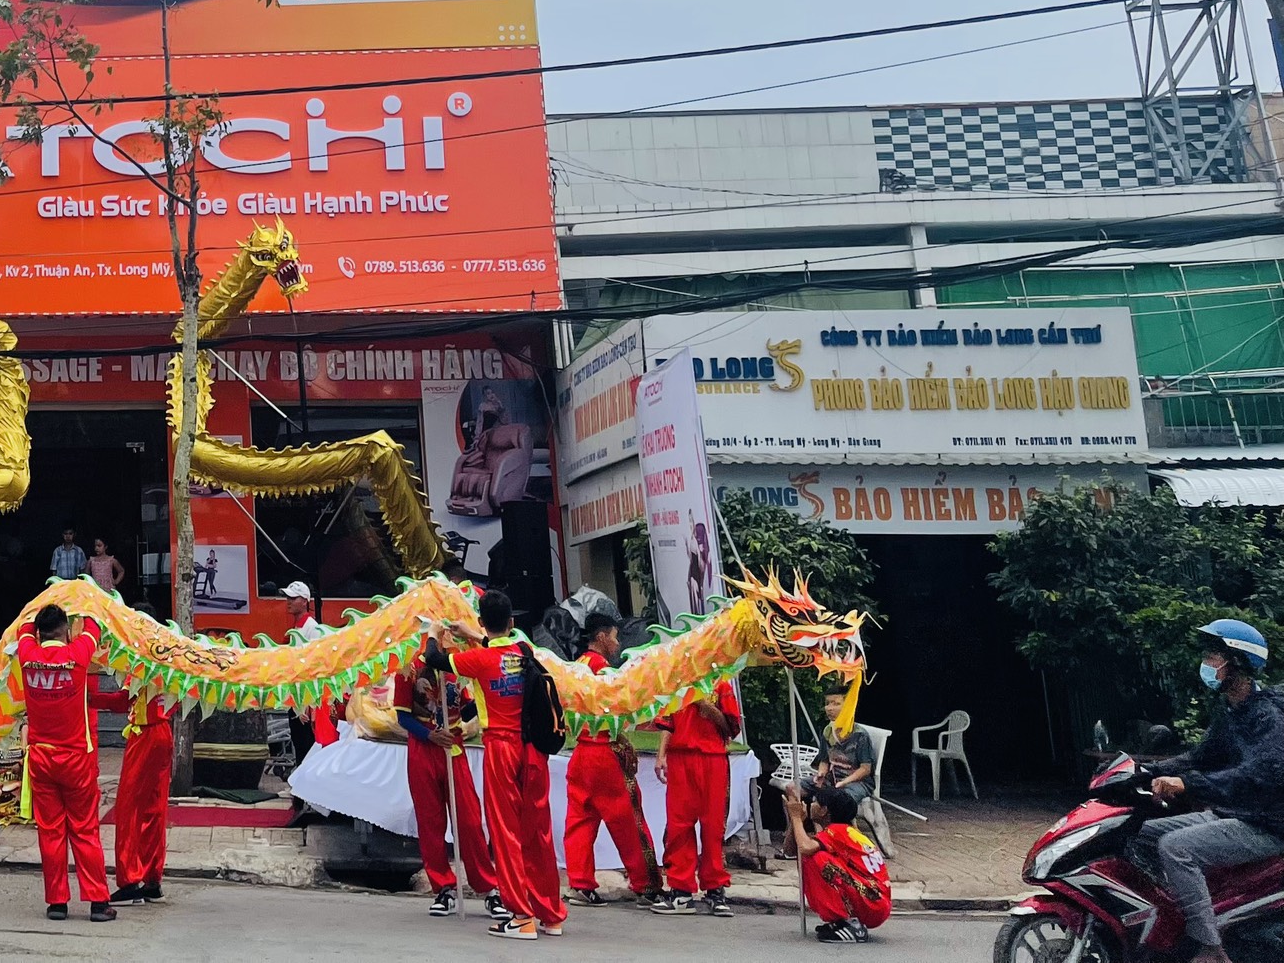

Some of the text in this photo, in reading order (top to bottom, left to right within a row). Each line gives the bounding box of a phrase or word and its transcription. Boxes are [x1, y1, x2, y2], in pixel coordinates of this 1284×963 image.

[37, 196, 94, 218] Giàu
[101, 194, 151, 217] Sức
[237, 193, 296, 215] Giàu
[304, 191, 372, 217] Hạnh
[380, 190, 449, 214] Phúc
[34, 264, 69, 280] Thuận
[74, 264, 94, 278] An,
[97, 264, 116, 276] Tx.
[119, 263, 148, 278] Long
[152, 261, 174, 278] Mỹ,
[996, 328, 1034, 345] LONG
[327, 344, 414, 381] CHÍNH
[422, 343, 503, 381] HÃNG
[710, 356, 775, 380] LONG
[696, 382, 761, 395] SURANCE
[811, 361, 1130, 416] PHÒNG BẢO HIỂM BẢO LONG HẬU GIANG
[832, 475, 892, 521] BẢO
[901, 471, 977, 521] HIỂM
[986, 475, 1036, 521] BẢ
